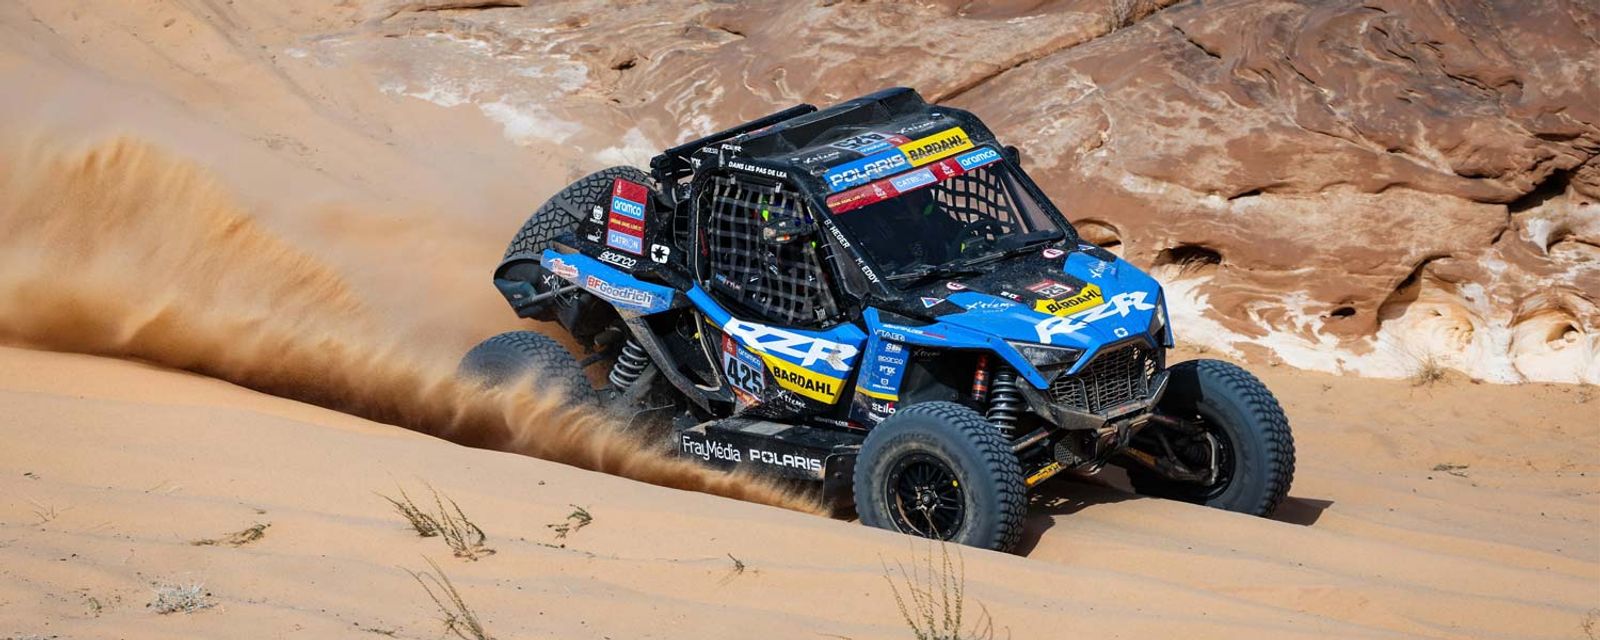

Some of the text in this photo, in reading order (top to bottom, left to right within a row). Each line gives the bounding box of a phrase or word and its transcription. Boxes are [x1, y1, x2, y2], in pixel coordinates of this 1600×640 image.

[908, 135, 967, 161] BARDAHL
[961, 150, 997, 166] aramco
[728, 161, 744, 170] DANS
[745, 164, 755, 172] LES
[755, 167, 767, 175] PAS
[829, 153, 906, 187] POLARIS
[614, 201, 642, 216] aramco
[824, 218, 851, 249] B. HEGER
[600, 251, 637, 267] sparco
[862, 265, 880, 283] EDDY
[587, 276, 651, 303] BFGoodrich
[1046, 289, 1102, 313] BARDAHL
[1034, 291, 1156, 343] RZR
[723, 316, 858, 371] RZR
[727, 357, 763, 397] 425
[773, 366, 835, 396] BARDAHL
[872, 402, 896, 414] stilo
[682, 436, 741, 462] FrayMédia
[750, 448, 822, 471] POLARIS
